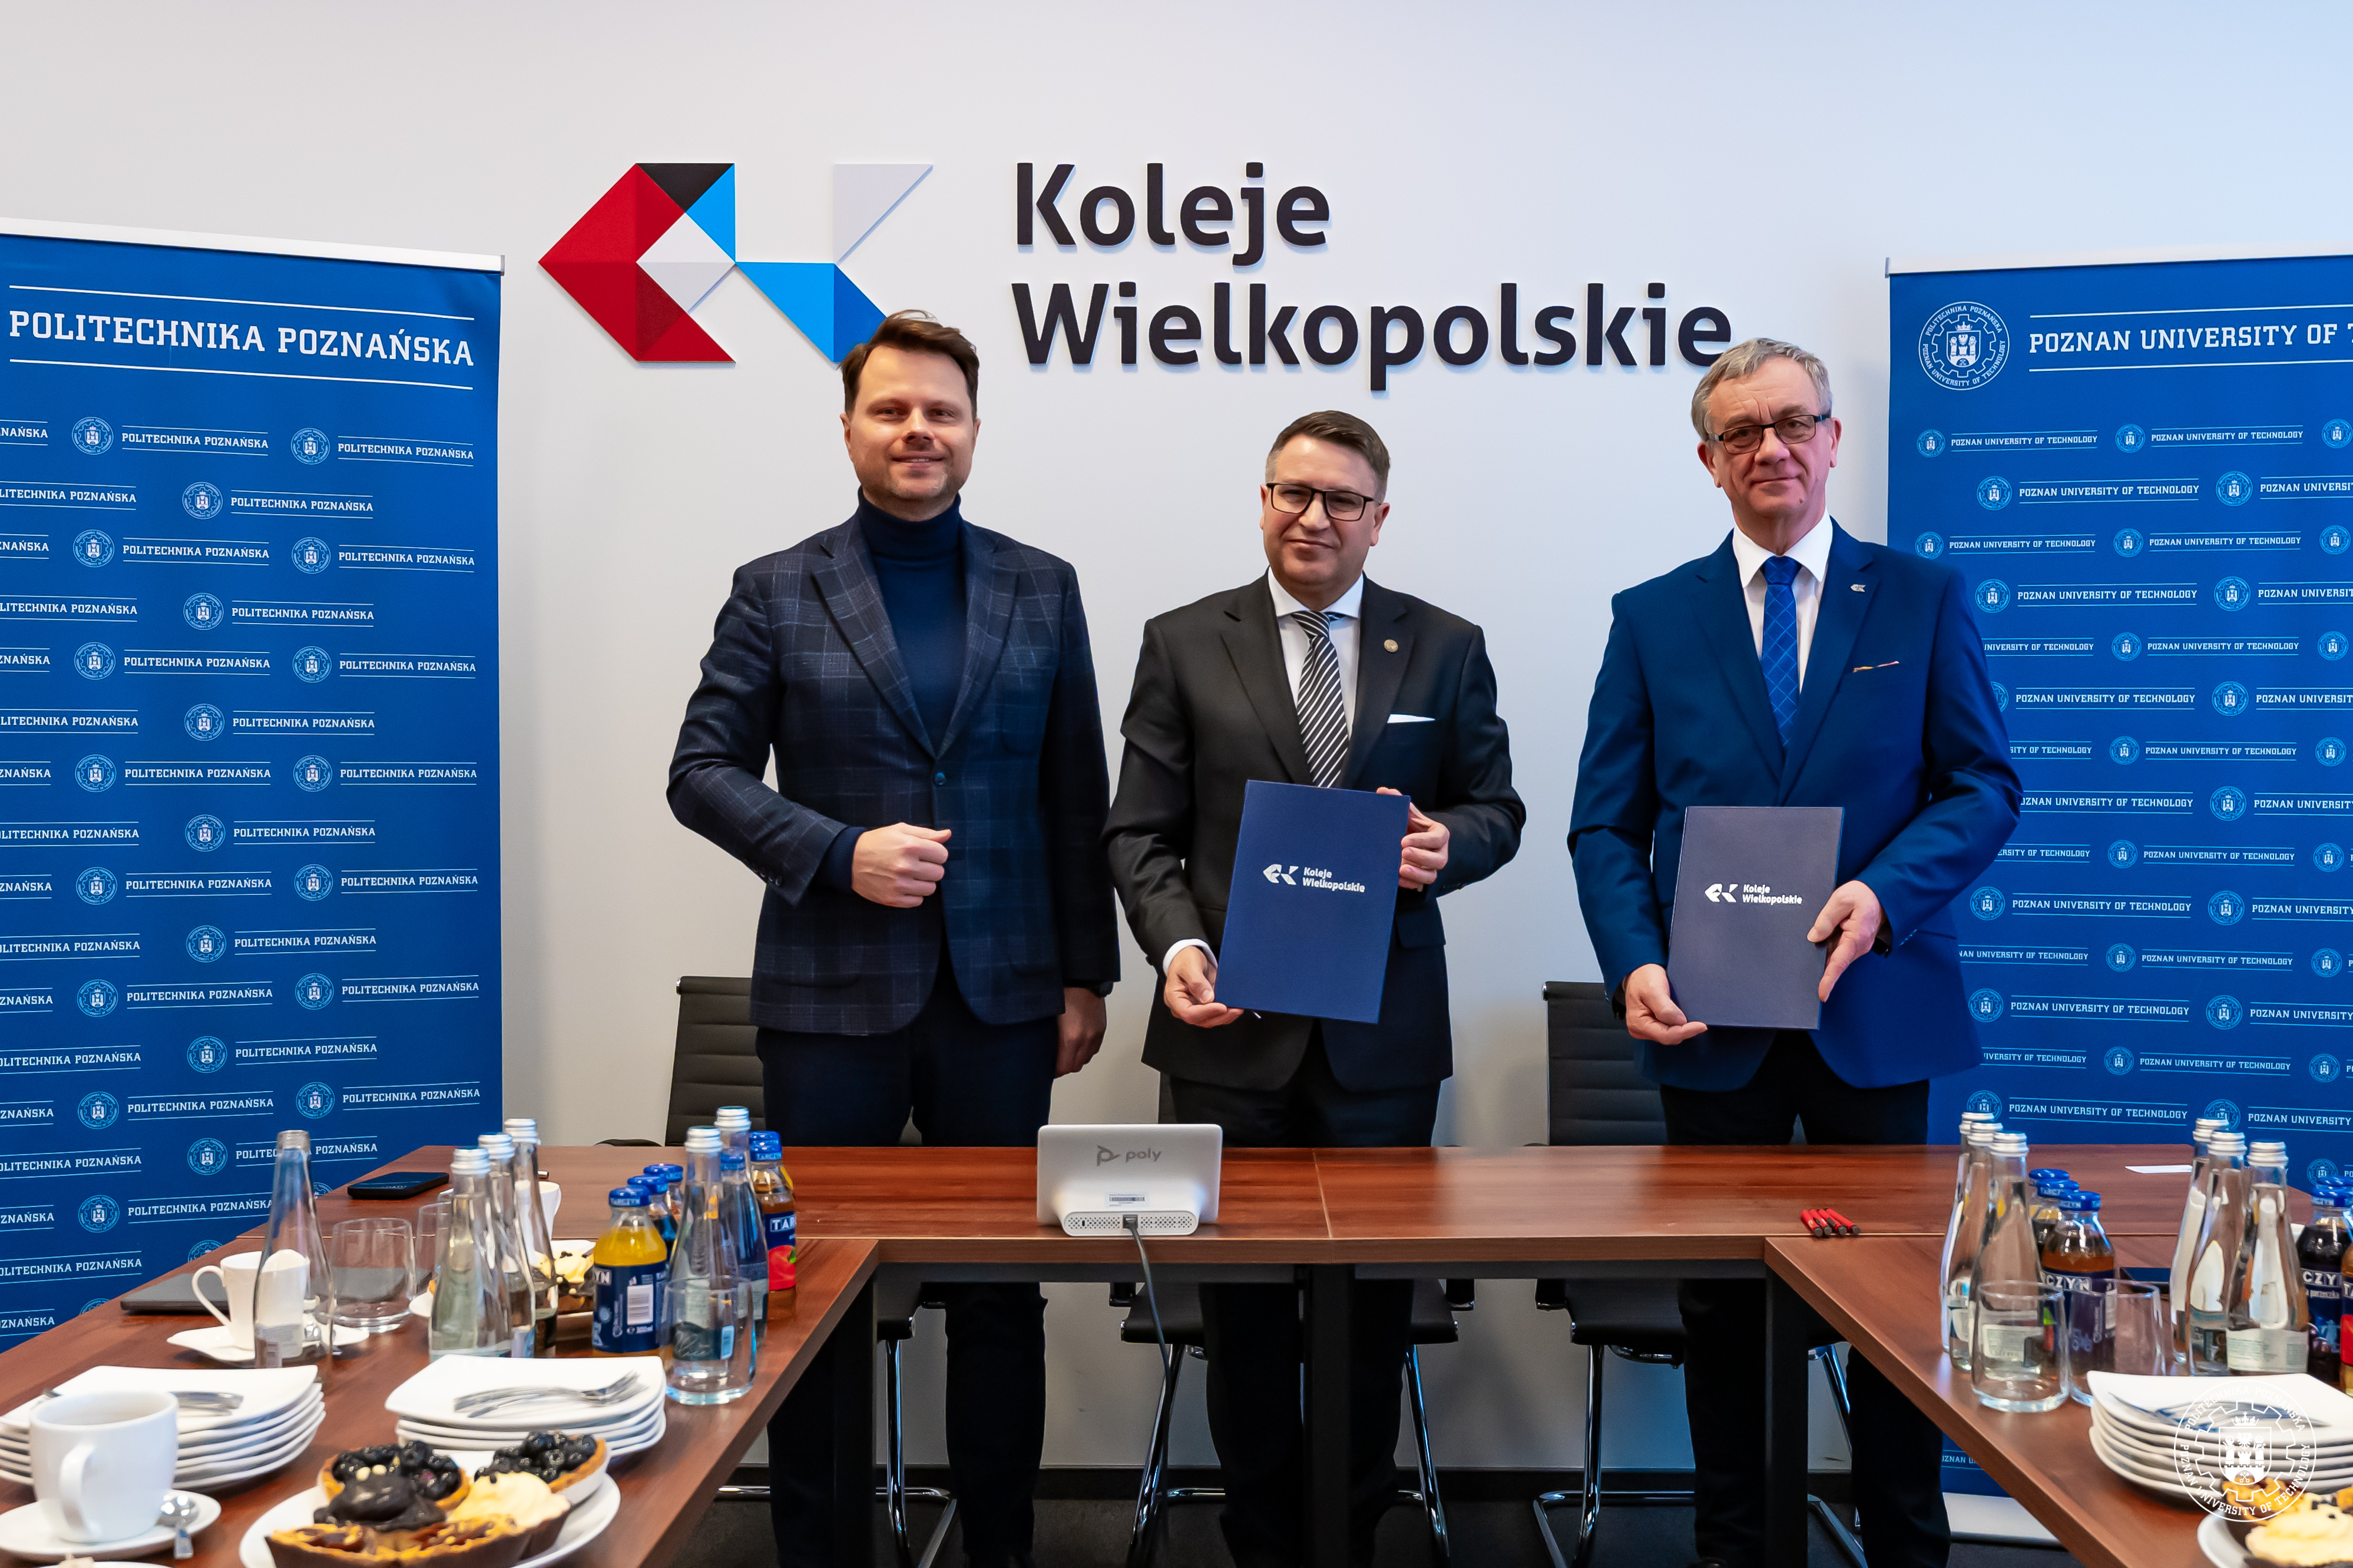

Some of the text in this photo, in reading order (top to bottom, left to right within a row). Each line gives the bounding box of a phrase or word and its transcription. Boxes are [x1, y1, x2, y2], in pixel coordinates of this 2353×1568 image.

[1016, 161, 1331, 267] Koleje
[1925, 305, 1967, 337] POLITECHNIKA
[9, 309, 474, 366] POLITECHNIKA POZNAŃSKA
[1011, 281, 1732, 392] Wielkopolskie
[2029, 330, 2131, 353] POZNAN
[2140, 324, 2297, 351] UNIVERSITY
[2307, 323, 2338, 344] OF
[1922, 340, 2006, 387] POZNAN UNIVERSITY OF TECHNOLOGY
[121, 432, 269, 449] POLITECHNIKA POZNAŃSKA
[1951, 438, 1983, 446] POZNAN
[1984, 437, 2033, 446] UNIVERSITY
[2047, 435, 2098, 444] TECHNOLOGY
[2151, 430, 2304, 442] POZNAN UNIVERSITY OF TECHNOLOGY
[337, 443, 474, 459] POLITECHNIKA POZNAŃSKA
[2019, 485, 2200, 497] POZNAN UNIVERSITY OF TECHNOLOGY
[2259, 483, 2301, 492] POZNAN
[70, 490, 137, 503] POZNAŃSKA
[230, 497, 374, 512] POLITECHNIKA POZNAŃSKA
[2044, 539, 2096, 548] TECHNOLOGY
[2149, 538, 2182, 546] POZNAN
[2184, 538, 2234, 546] UNIVERSITY
[2248, 536, 2301, 545] TECHNOLOGY
[123, 545, 270, 558] POLITECHNIKA POZNAŃSKA
[338, 552, 475, 566] POLITECHNIKA POZNAŃSKA
[2017, 589, 2198, 600] POZNAN UNIVERSITY OF TECHNOLOGY
[2258, 589, 2298, 598] POZNAN
[71, 602, 138, 615] POZNAŃSKA
[231, 608, 375, 620] POLITECHNIKA POZNAŃSKA
[124, 657, 270, 668] POLITECHNIKA POZNAŃSKA
[339, 660, 476, 672] POLITECHNIKA POZNAŃSKA
[2016, 694, 2196, 703] POZNAN UNIVERSITY OF TECHNOLOGY
[2256, 694, 2296, 703] POZNAN
[72, 715, 139, 727] POZNAŃSKA
[232, 717, 375, 728] POLITECHNIKA POZNAŃSKA
[2244, 747, 2297, 755] TECHNOLOGY
[124, 767, 272, 778] POLITECHNIKA POZNAŃSKA
[340, 767, 477, 778] POLITECHNIKA POZNAŃSKA
[2055, 797, 2193, 807] UNIVERSITY OF TECHNOLOGY
[2253, 800, 2294, 808] POZNAN
[72, 827, 140, 838] POZNAŃSKA
[233, 825, 376, 837] POLITECHNIKA POZNAŃSKA
[2179, 851, 2228, 860] UNIVERSITY
[1303, 867, 1333, 878] Koleje
[125, 877, 272, 890] POLITECHNIKA POZNAŃSKA
[340, 874, 478, 887] POLITECHNIKA POZNAŃSKA
[1302, 877, 1366, 893] Wielkopolskie
[1743, 884, 1771, 894] Koleje
[1742, 894, 1803, 906] Wielkopolskie
[2012, 900, 2192, 911] POZNAN UNIVERSITY OF TECHNOLOGY
[2252, 904, 2292, 913] POZNAN
[74, 939, 141, 952] POZNAŃSKA
[234, 934, 377, 947] POLITECHNIKA POZNAŃSKA
[2176, 955, 2226, 964] UNIVERSITY
[2240, 957, 2293, 966] TECHNOLOGY
[127, 987, 273, 1002] POLITECHNIKA POZNAŃSKA
[342, 981, 479, 995] POLITECHNIKA POZNAŃSKA
[2010, 1002, 2189, 1015] POZNAN UNIVERSITY OF TECHNOLOGY
[2250, 1009, 2353, 1020] POZNAN UNIVERSITY
[235, 1042, 378, 1058] POLITECHNIKA POZNAŃSKA
[75, 1051, 141, 1064] POZNAŃSKA
[2140, 1058, 2172, 1066] POZNAN
[2175, 1059, 2224, 1068] UNIVERSITY
[2238, 1061, 2291, 1070] TECHNOLOGY
[342, 1088, 481, 1103] POLITECHNIKA POZNAŃSKA
[127, 1097, 274, 1113] POLITECHNIKA POZNAŃSKA
[2008, 1104, 2188, 1119] POZNAN UNIVERSITY OF TECHNOLOGY
[2248, 1113, 2352, 1126] POZNAN UNIVERSITY
[315, 1142, 378, 1155] POZNAŃSKA
[75, 1154, 142, 1168] POZNAŃSKA
[1126, 1148, 1162, 1163] poly
[128, 1199, 272, 1216] POLITECHNIKA POZNAŃSKA
[75, 1258, 143, 1271] POZNAŃSKA
